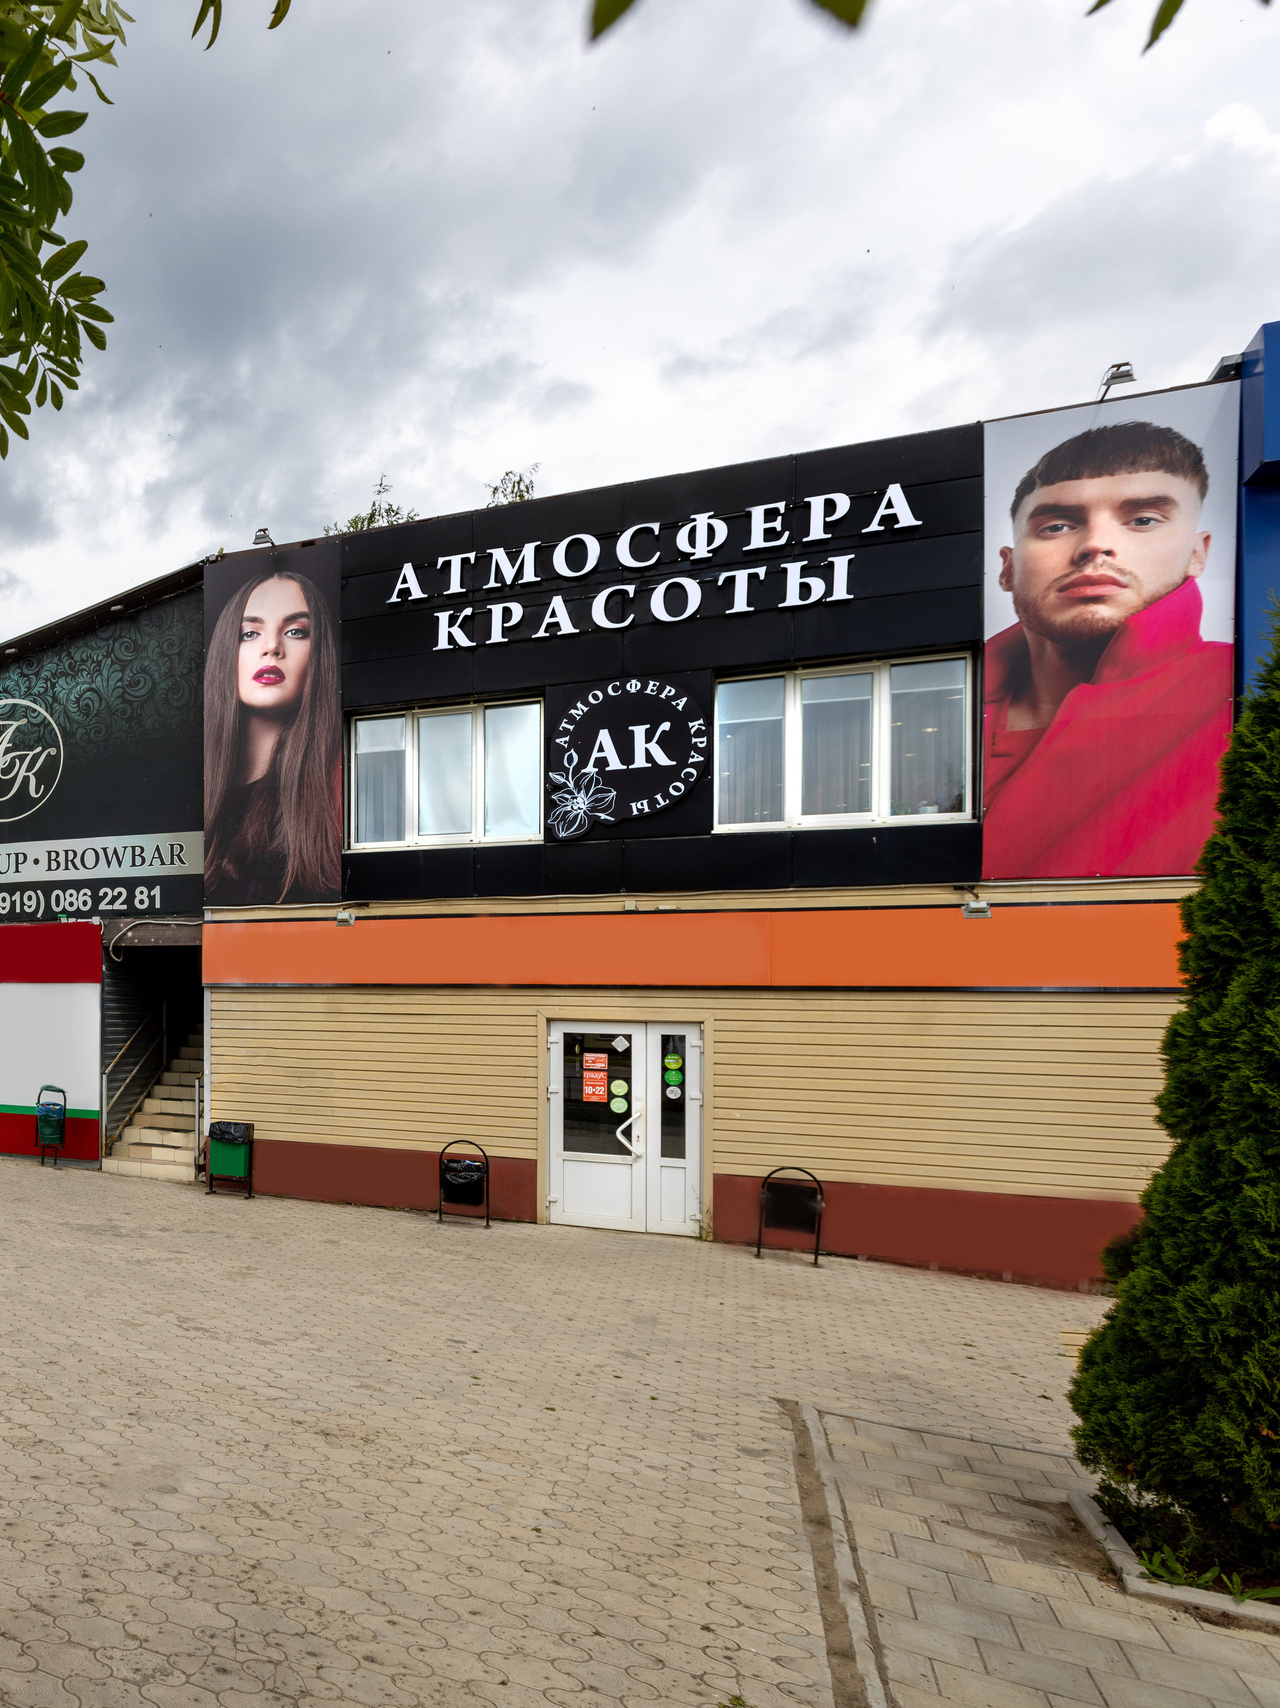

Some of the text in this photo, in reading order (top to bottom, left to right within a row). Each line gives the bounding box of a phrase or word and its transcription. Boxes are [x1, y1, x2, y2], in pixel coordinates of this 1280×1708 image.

[386, 483, 923, 604] АТМОСФЕРА
[433, 554, 855, 650] КРАСОТЫ
[555, 679, 708, 816] АТМОСФЕРА КРАСОТЫ
[581, 721, 677, 772] АК
[44, 842, 188, 873] BROWBAR
[50, 888, 92, 913] 086
[98, 886, 128, 911] 22
[134, 885, 162, 909] 81
